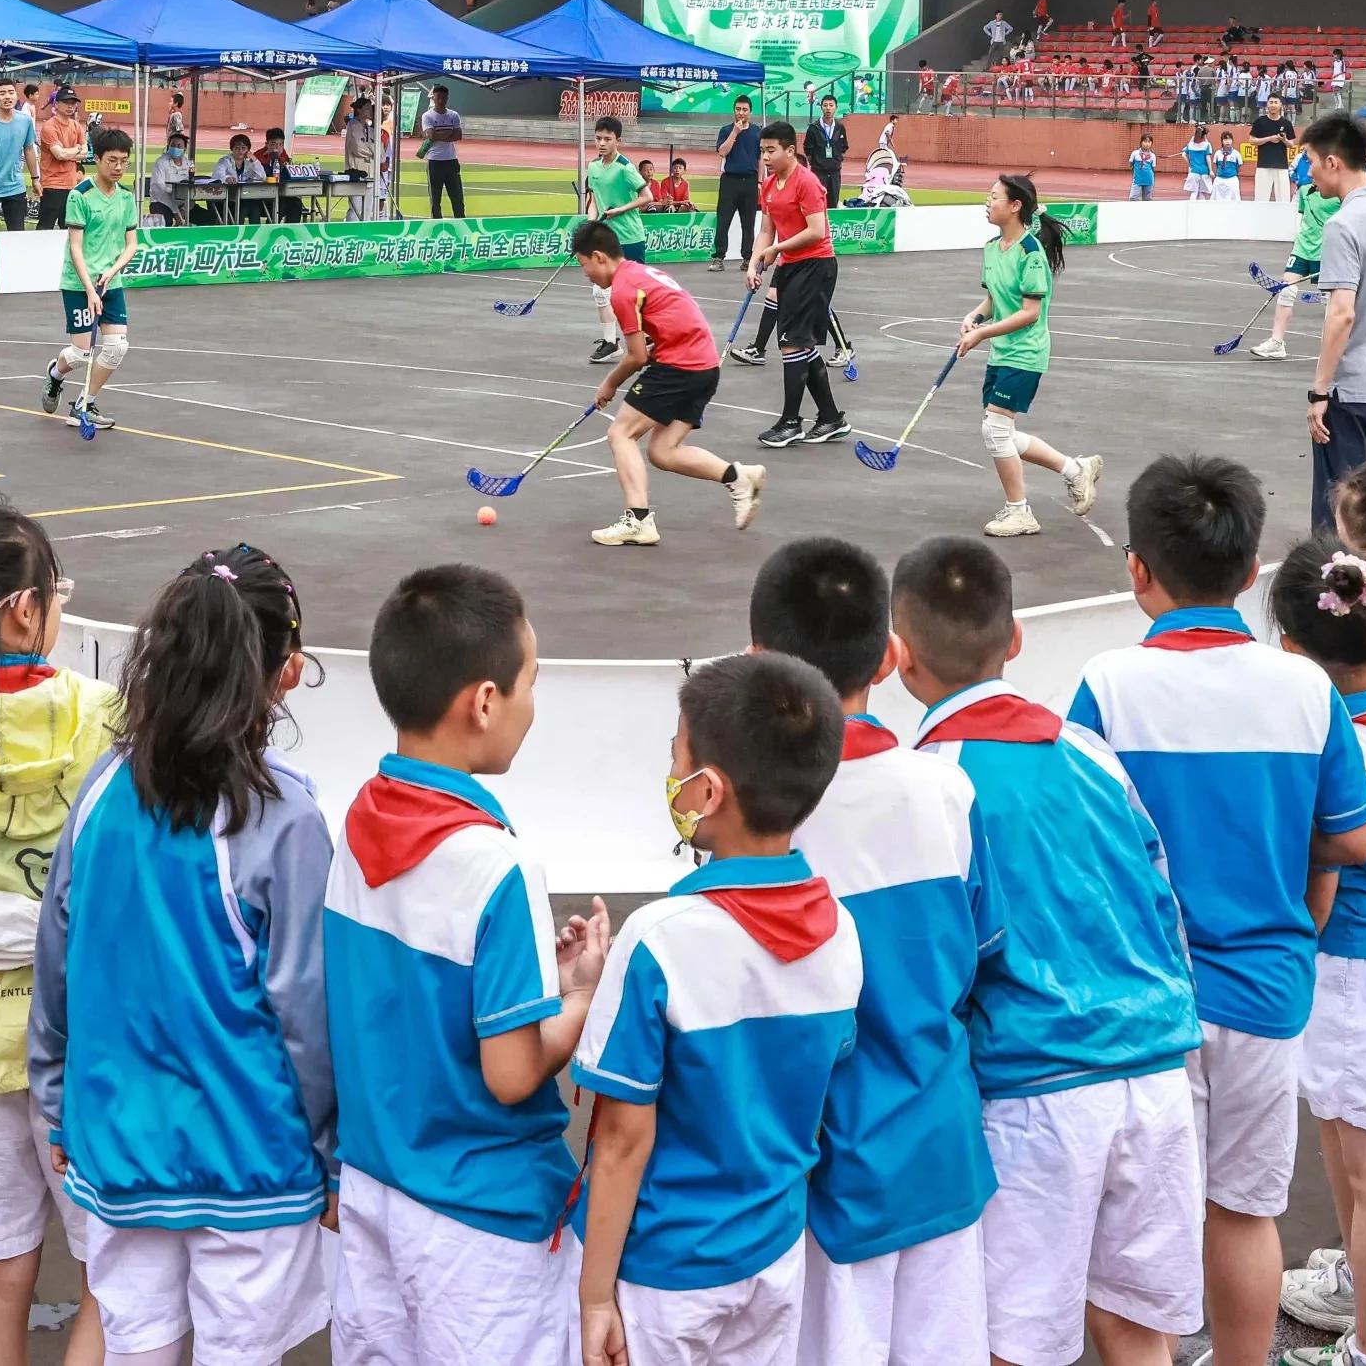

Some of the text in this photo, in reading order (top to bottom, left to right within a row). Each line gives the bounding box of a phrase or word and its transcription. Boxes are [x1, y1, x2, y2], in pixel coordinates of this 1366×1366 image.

[732, 14, 821, 30] 旱地冰球比赛
[219, 50, 319, 66] 成都市冰雪运动协会
[442, 59, 529, 73] 成都市冰雪运动协会
[640, 66, 719, 81] 成都市冰雪运动协会
[830, 224, 876, 240] 市体育局
[72, 308, 91, 328] 38
